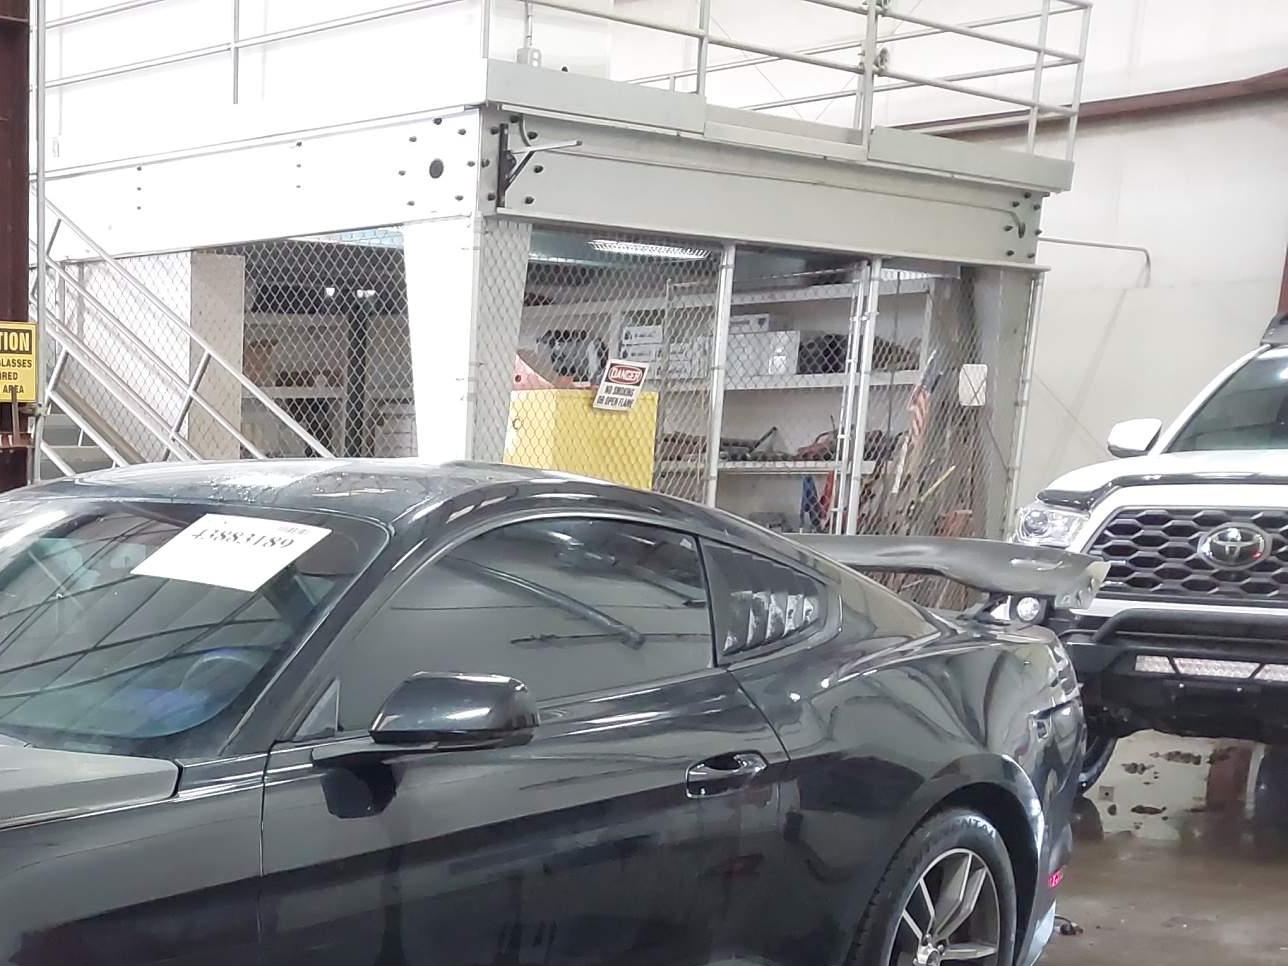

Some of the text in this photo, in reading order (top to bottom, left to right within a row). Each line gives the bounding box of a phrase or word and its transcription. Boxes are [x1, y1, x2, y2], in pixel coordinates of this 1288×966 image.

[611, 366, 642, 382] DANGER
[3, 384, 25, 394] AREA
[604, 385, 636, 397] NO SMOKING
[596, 395, 605, 404] OR
[604, 396, 619, 406] OPEN
